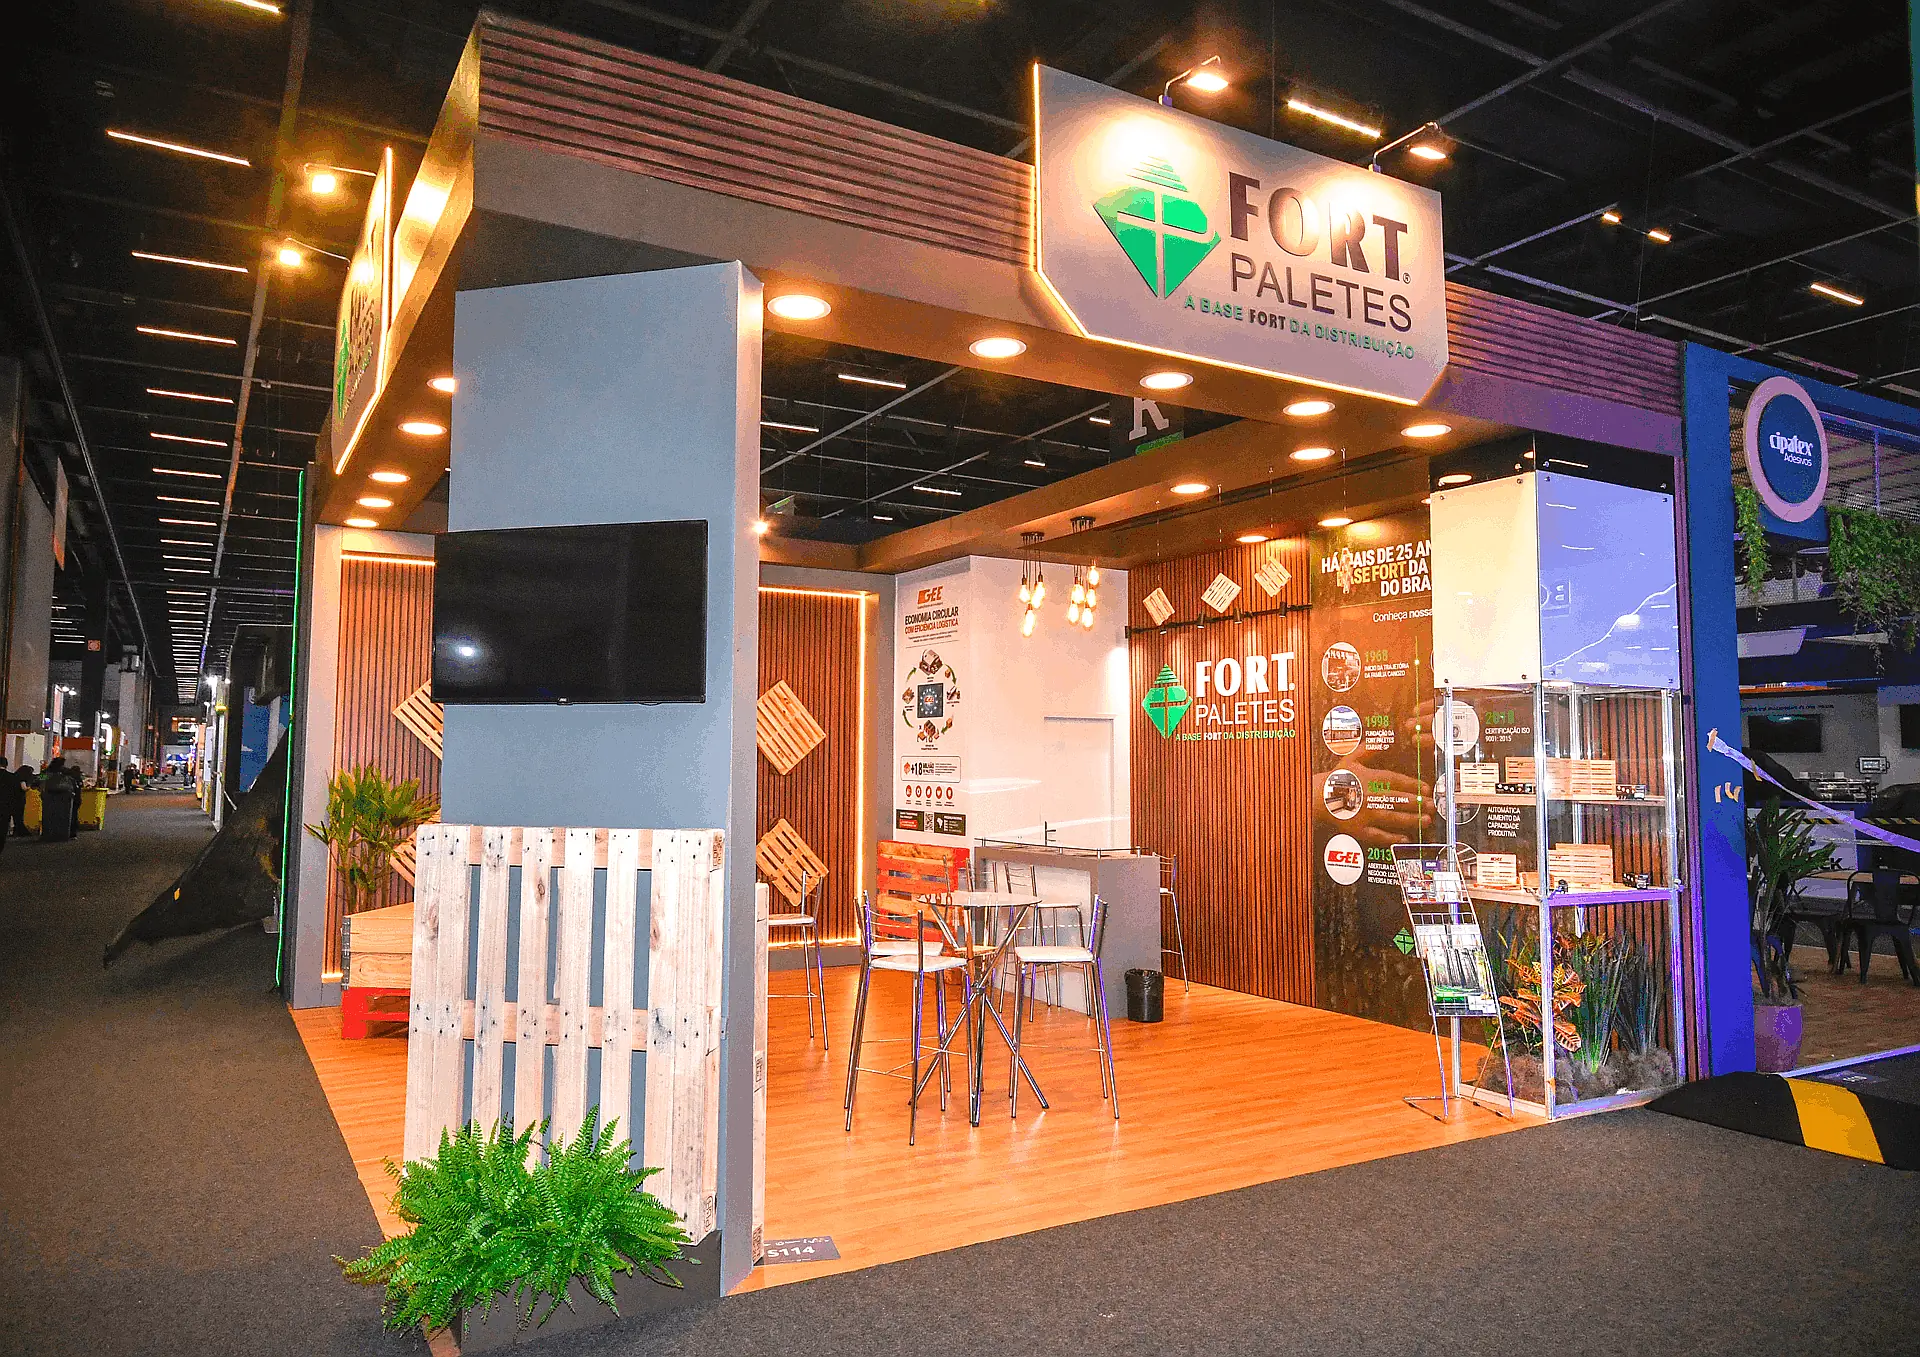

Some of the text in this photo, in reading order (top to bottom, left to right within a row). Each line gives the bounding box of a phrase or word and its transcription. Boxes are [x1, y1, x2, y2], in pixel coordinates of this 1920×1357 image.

[1231, 252, 1412, 333] PALETES
[1184, 295, 1415, 360] A BASE FORT DA DISTRIBUIÇÃO
[1769, 432, 1814, 457] cipatex
[1783, 453, 1813, 467] Adesivos
[1321, 551, 1340, 574] HÁ
[1377, 546, 1395, 564] DE
[1396, 543, 1413, 561] 25
[1372, 561, 1407, 581] FORT
[1408, 558, 1429, 576] DA
[1380, 579, 1400, 597] DO
[1373, 611, 1408, 623] Conheça
[1195, 698, 1295, 727] PALETES
[1175, 728, 1296, 742] A BASE FORT DA DISTRIBUIÇÃO
[1485, 726, 1521, 735] CERTIFICAÇÃO
[1487, 806, 1521, 814] AUTOMÁTICA
[1487, 822, 1520, 830] CAPACIDADE
[1487, 829, 1517, 838] PRODUTIVA
